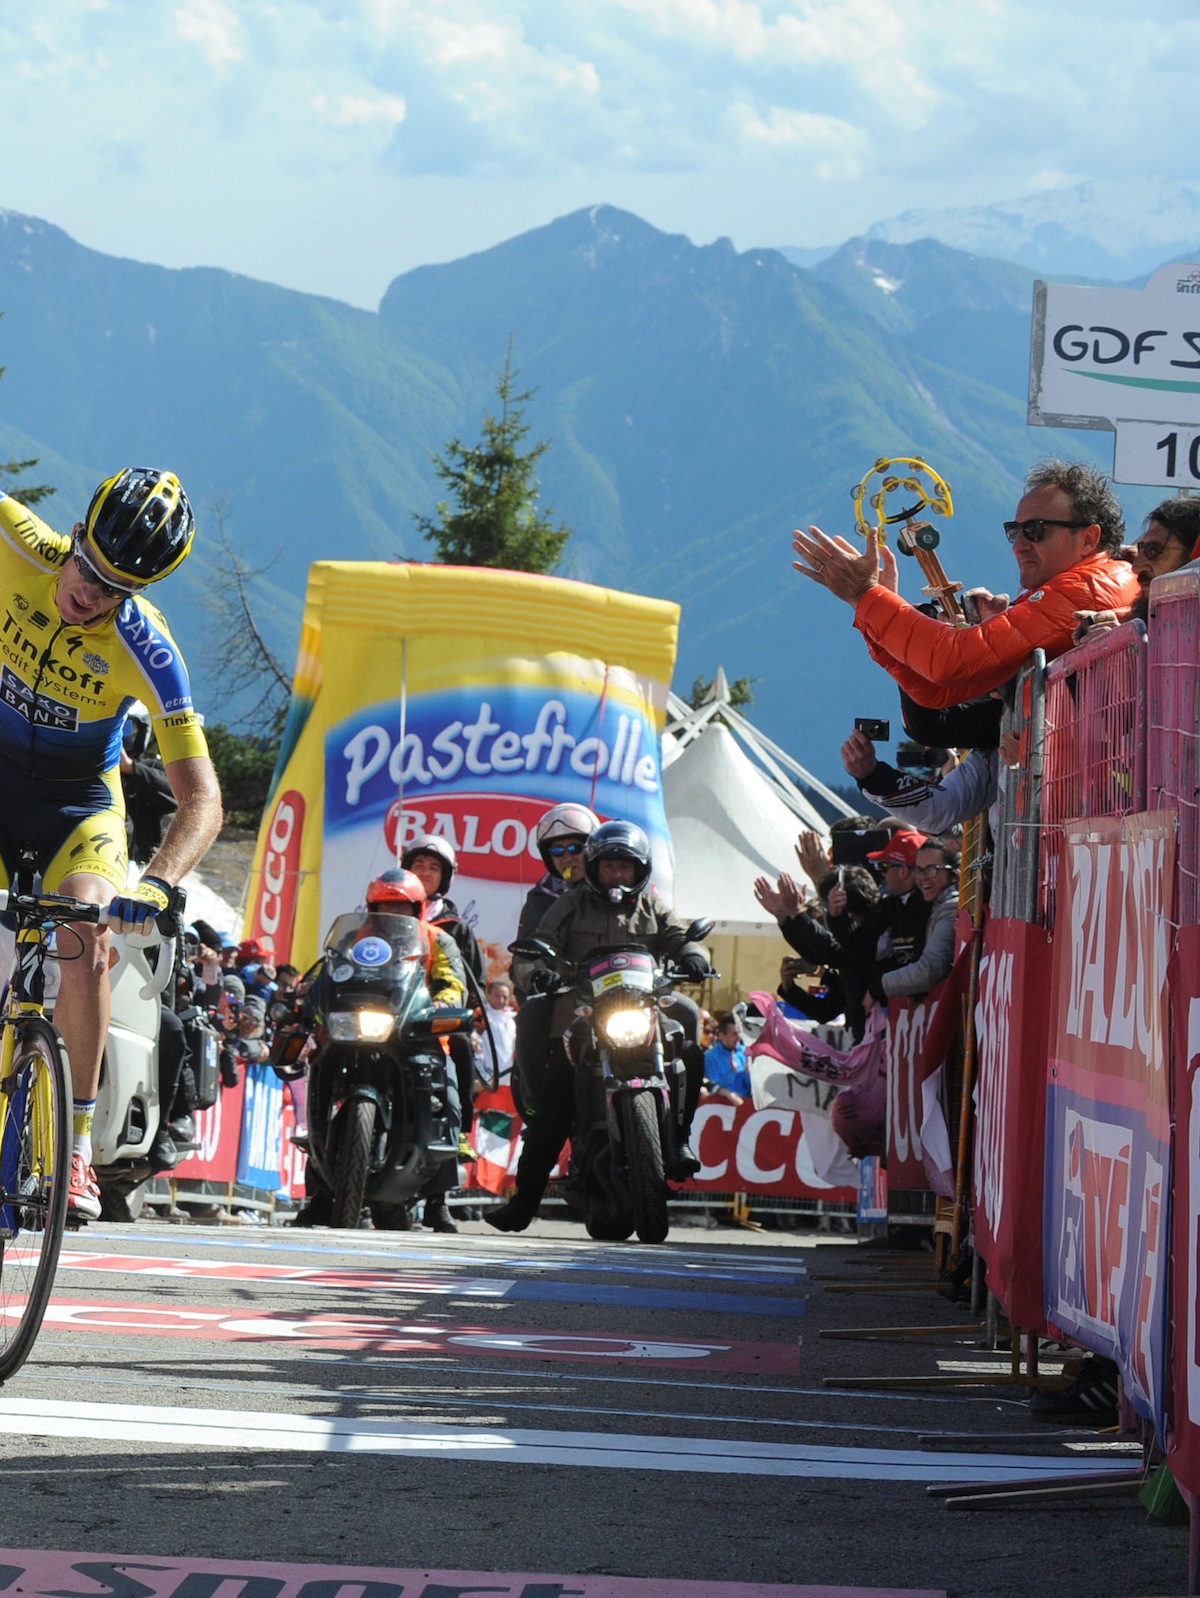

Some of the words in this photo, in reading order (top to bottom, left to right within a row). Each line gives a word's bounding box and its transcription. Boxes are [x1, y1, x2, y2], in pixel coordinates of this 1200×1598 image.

[1053, 325, 1168, 365] GDF
[2, 609, 106, 695] Tinkoff
[120, 604, 174, 669] SAXO
[5, 689, 69, 728] BANK
[6, 674, 71, 718] SAXO
[344, 700, 658, 805] Pastefrolle
